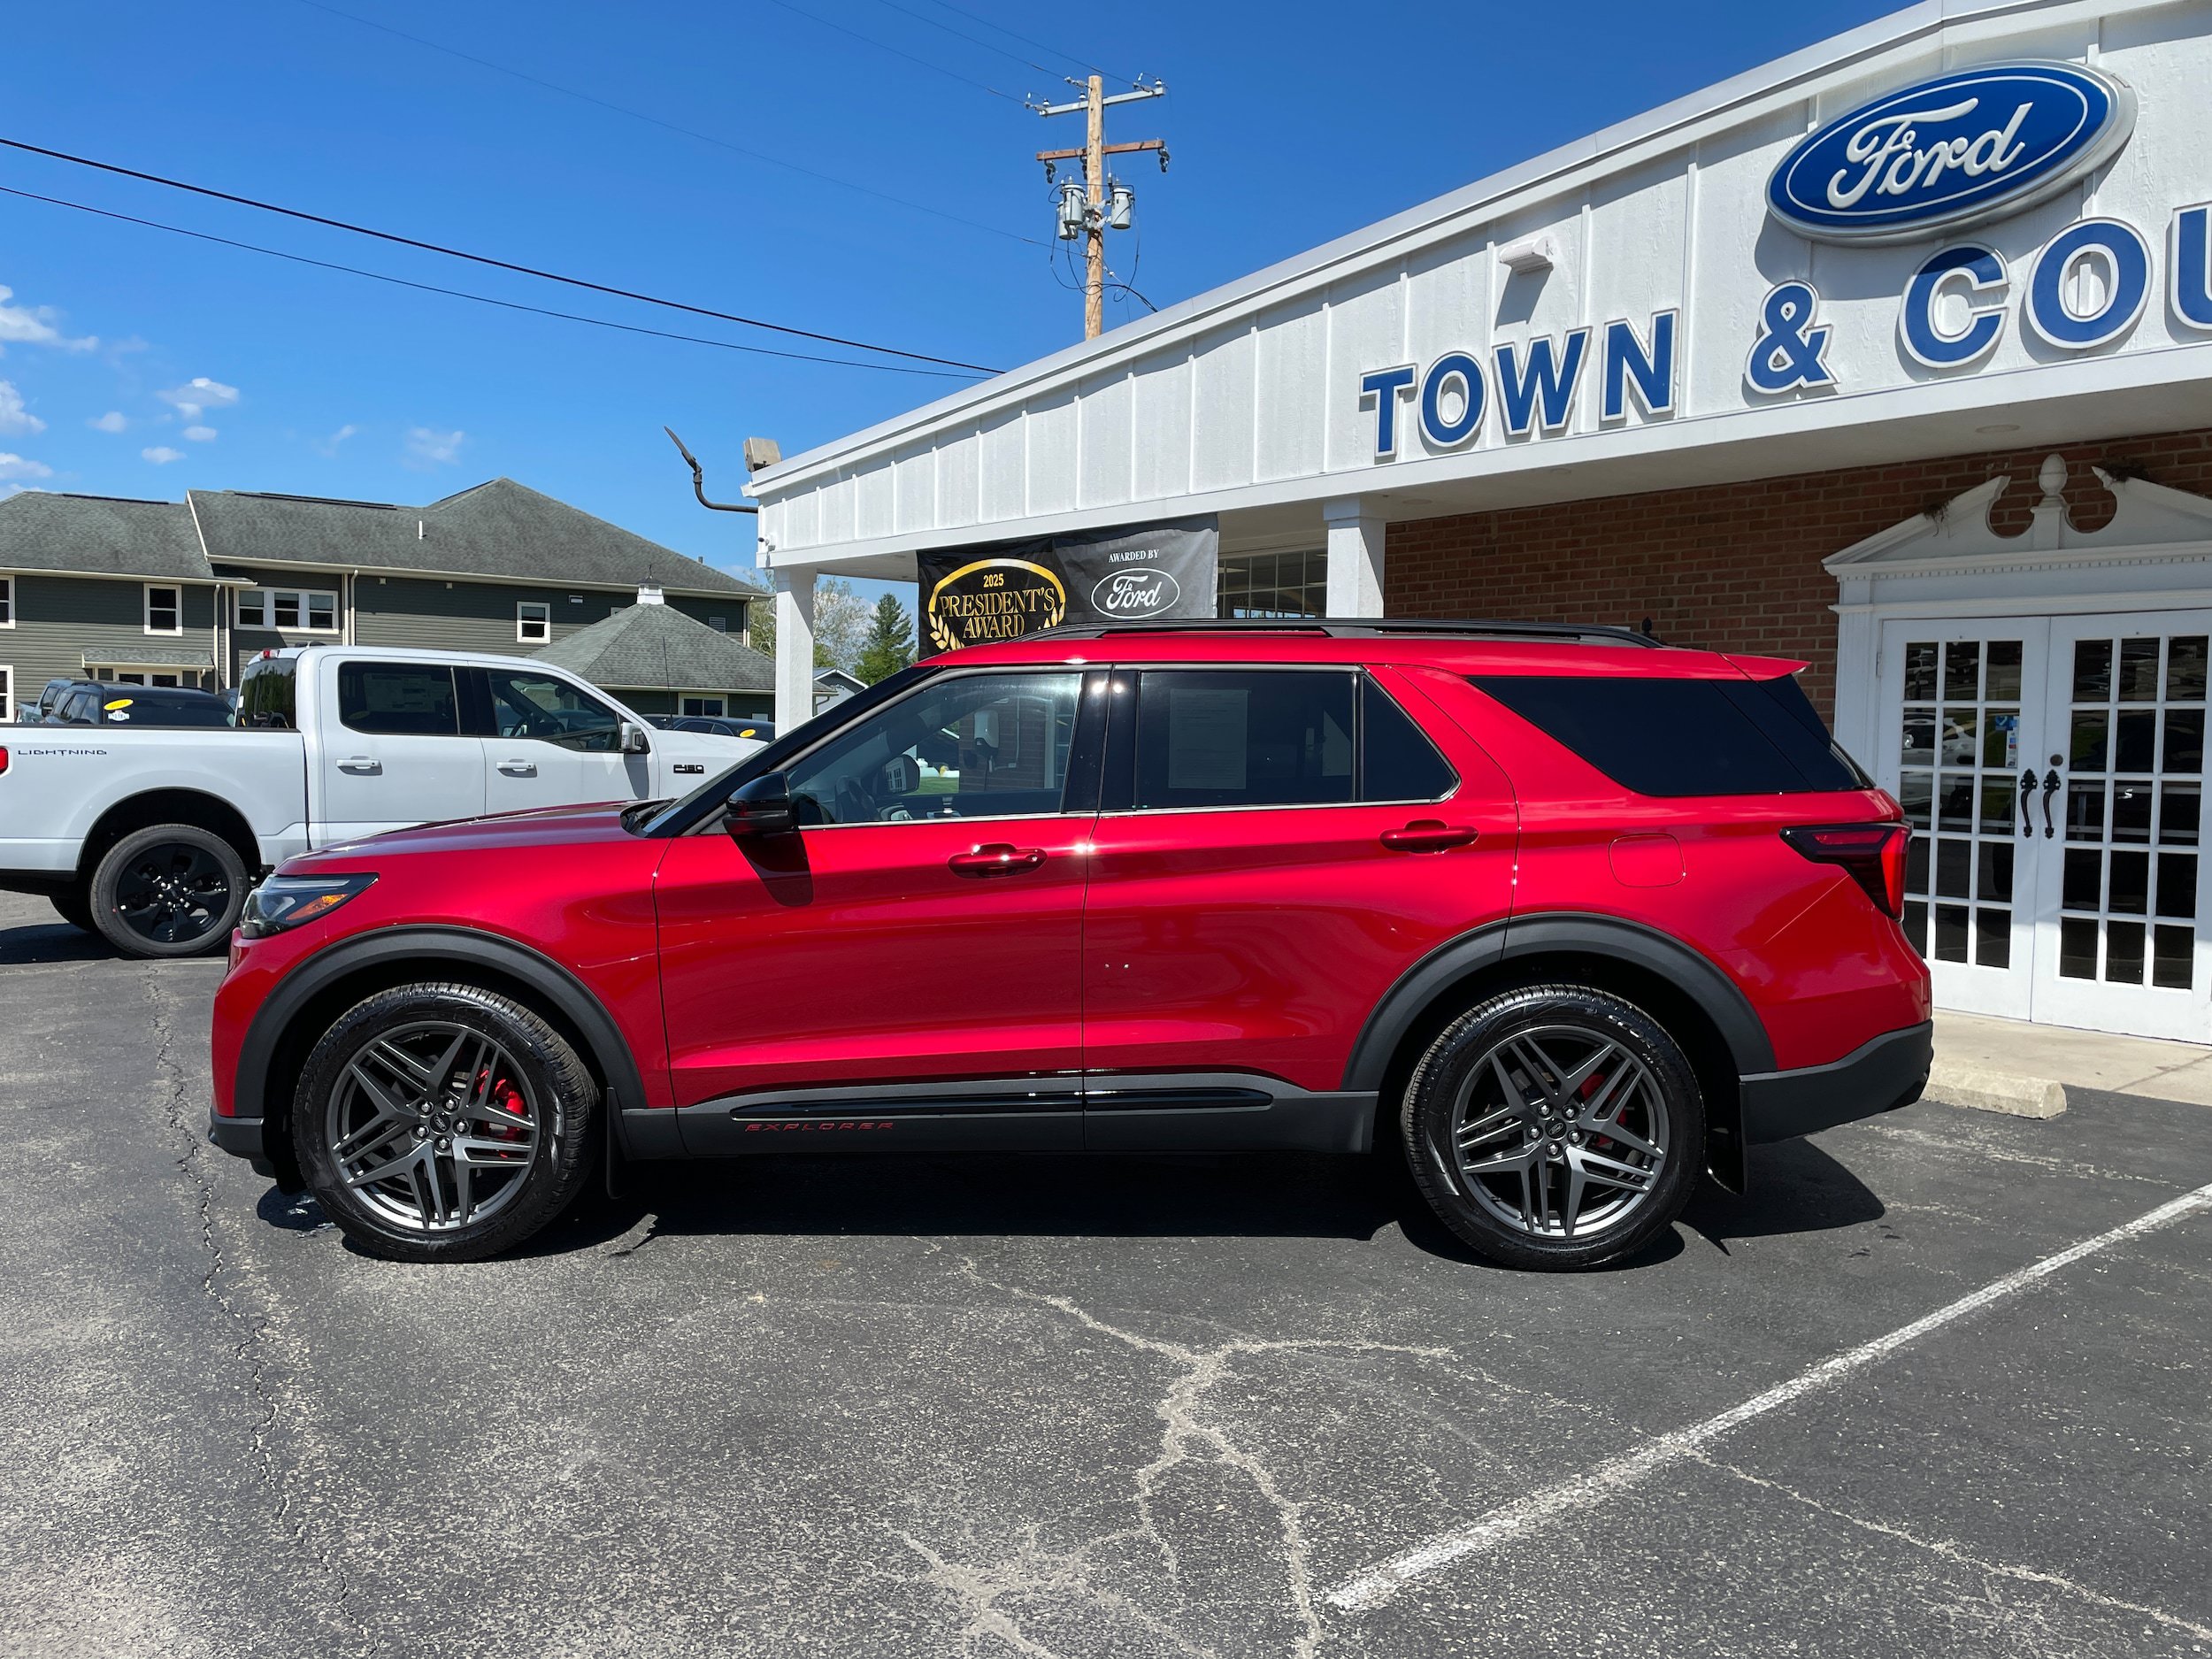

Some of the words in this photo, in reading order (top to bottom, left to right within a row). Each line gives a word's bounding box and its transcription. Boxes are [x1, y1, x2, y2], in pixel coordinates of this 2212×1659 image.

[1826, 97, 2033, 209] Ford
[1360, 308, 1679, 457] TOWN
[1745, 280, 1840, 395] &
[1109, 550, 1147, 563] AWARDED
[1148, 549, 1160, 559] BY
[983, 573, 1004, 588] 2025
[1106, 575, 1162, 610] Ford
[939, 587, 1056, 618] PRESIDENT'S
[963, 614, 1025, 639] AWARD
[745, 1122, 894, 1133] EXPLORER
